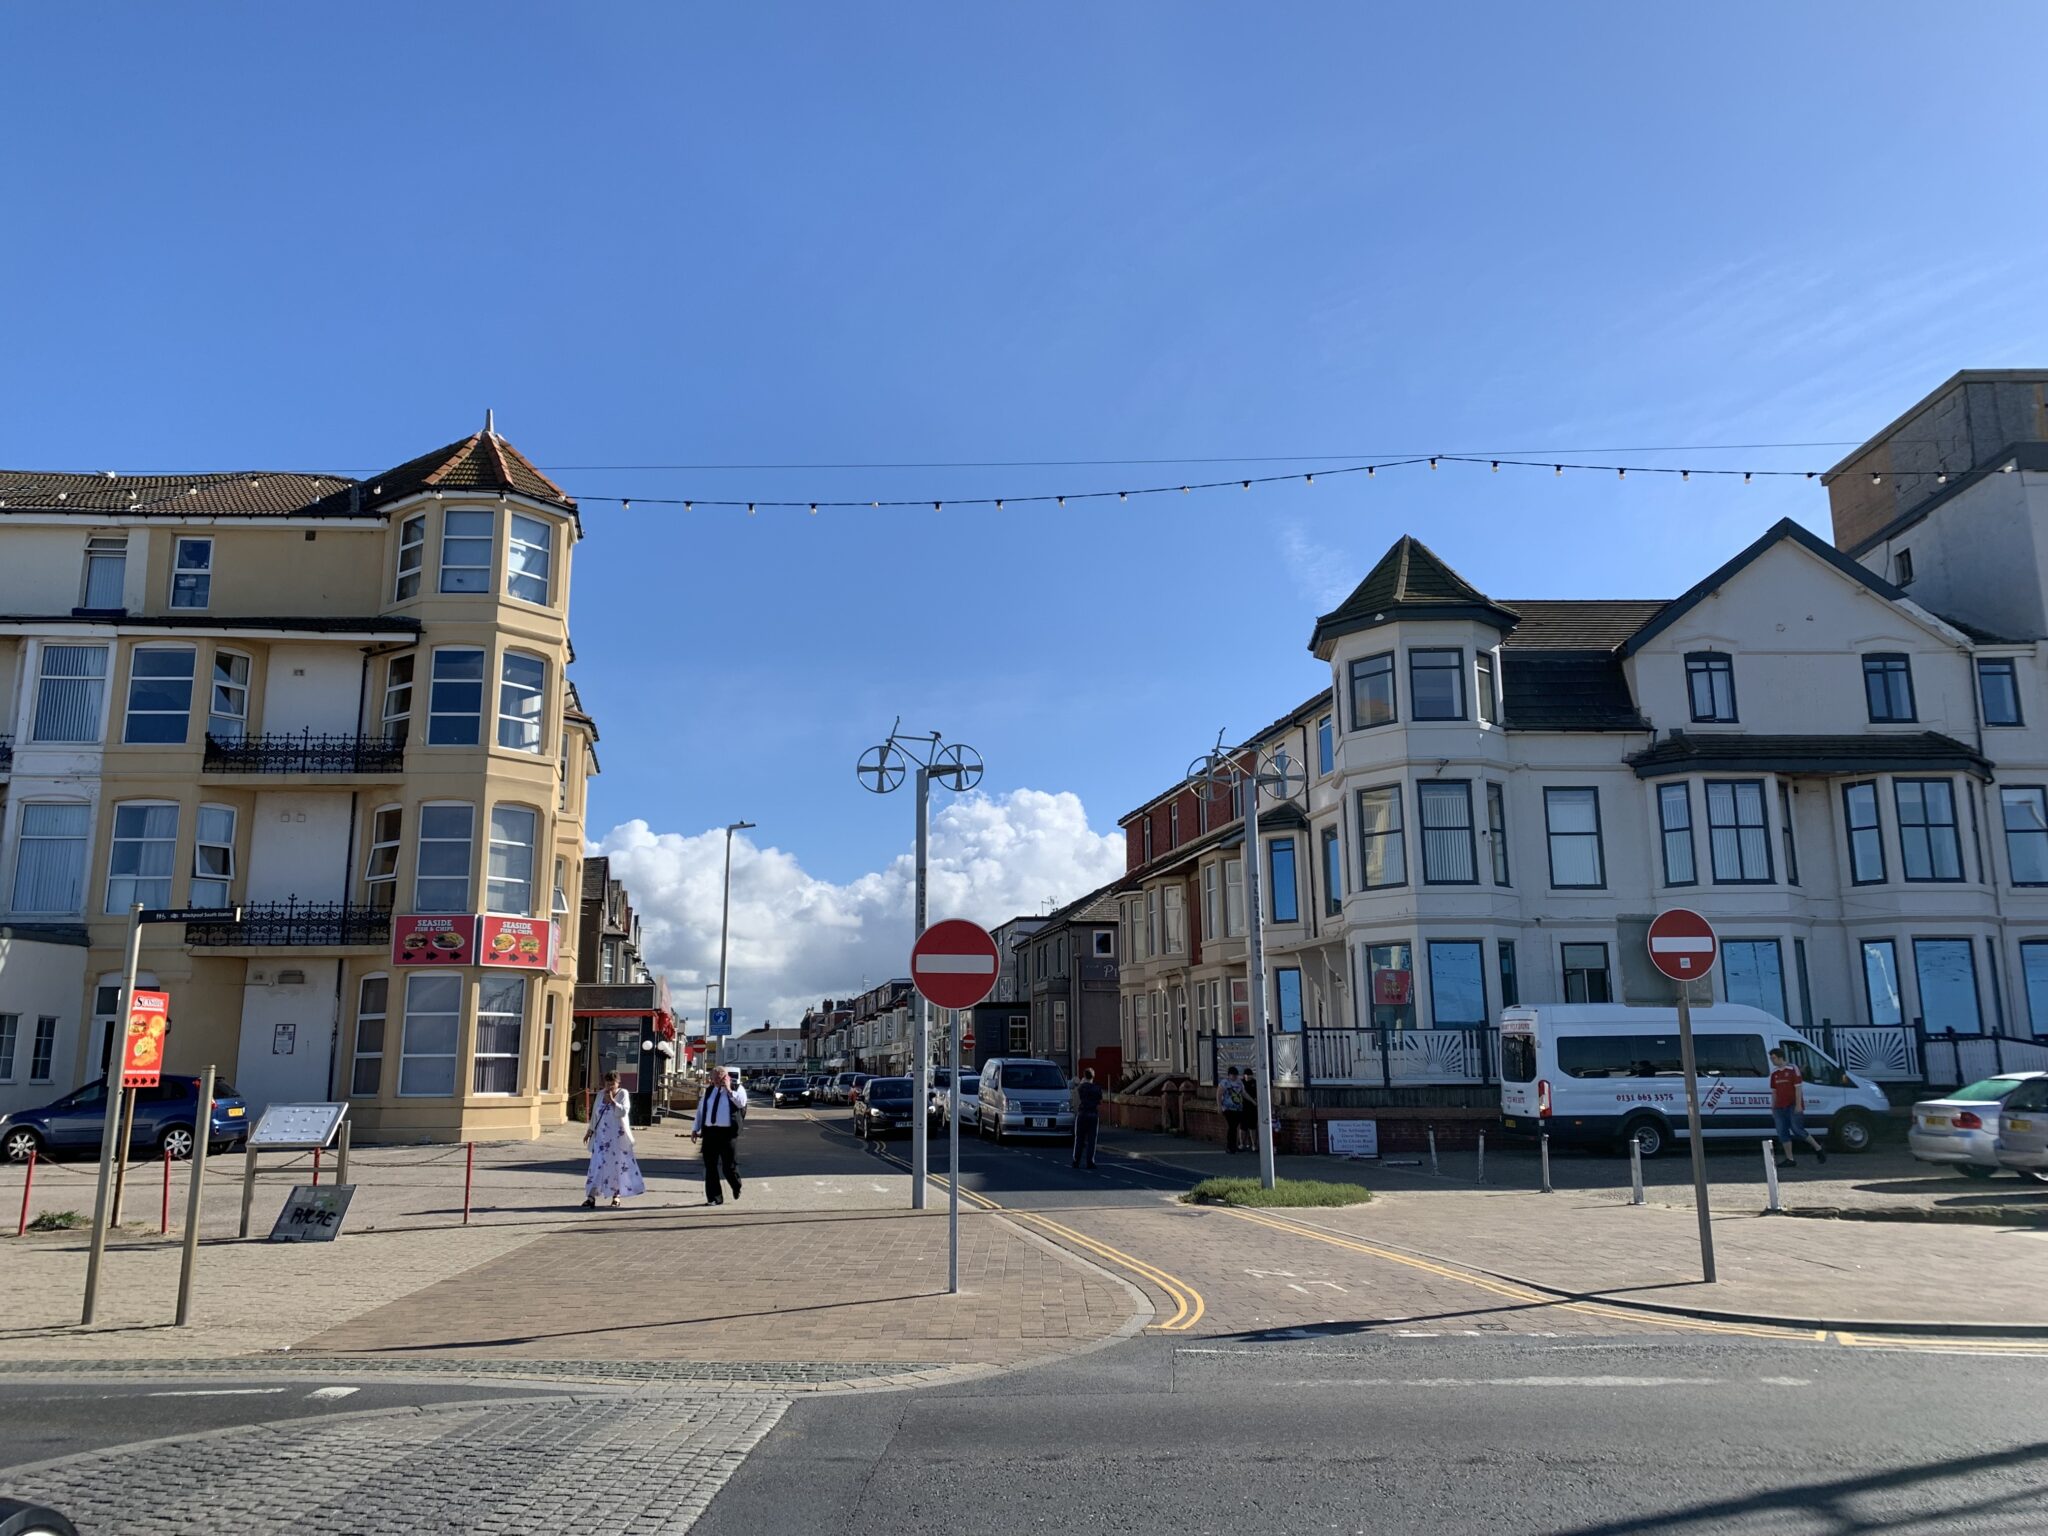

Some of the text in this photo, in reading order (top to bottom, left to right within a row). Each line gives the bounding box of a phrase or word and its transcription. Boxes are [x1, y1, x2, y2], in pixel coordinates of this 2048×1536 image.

[417, 919, 452, 927] SEASIDE
[502, 921, 532, 929] SEASIDE
[1616, 1094, 1635, 1102] 0131
[1654, 1093, 1674, 1101] 3375
[1730, 1096, 1770, 1104] SELF DRIVE
